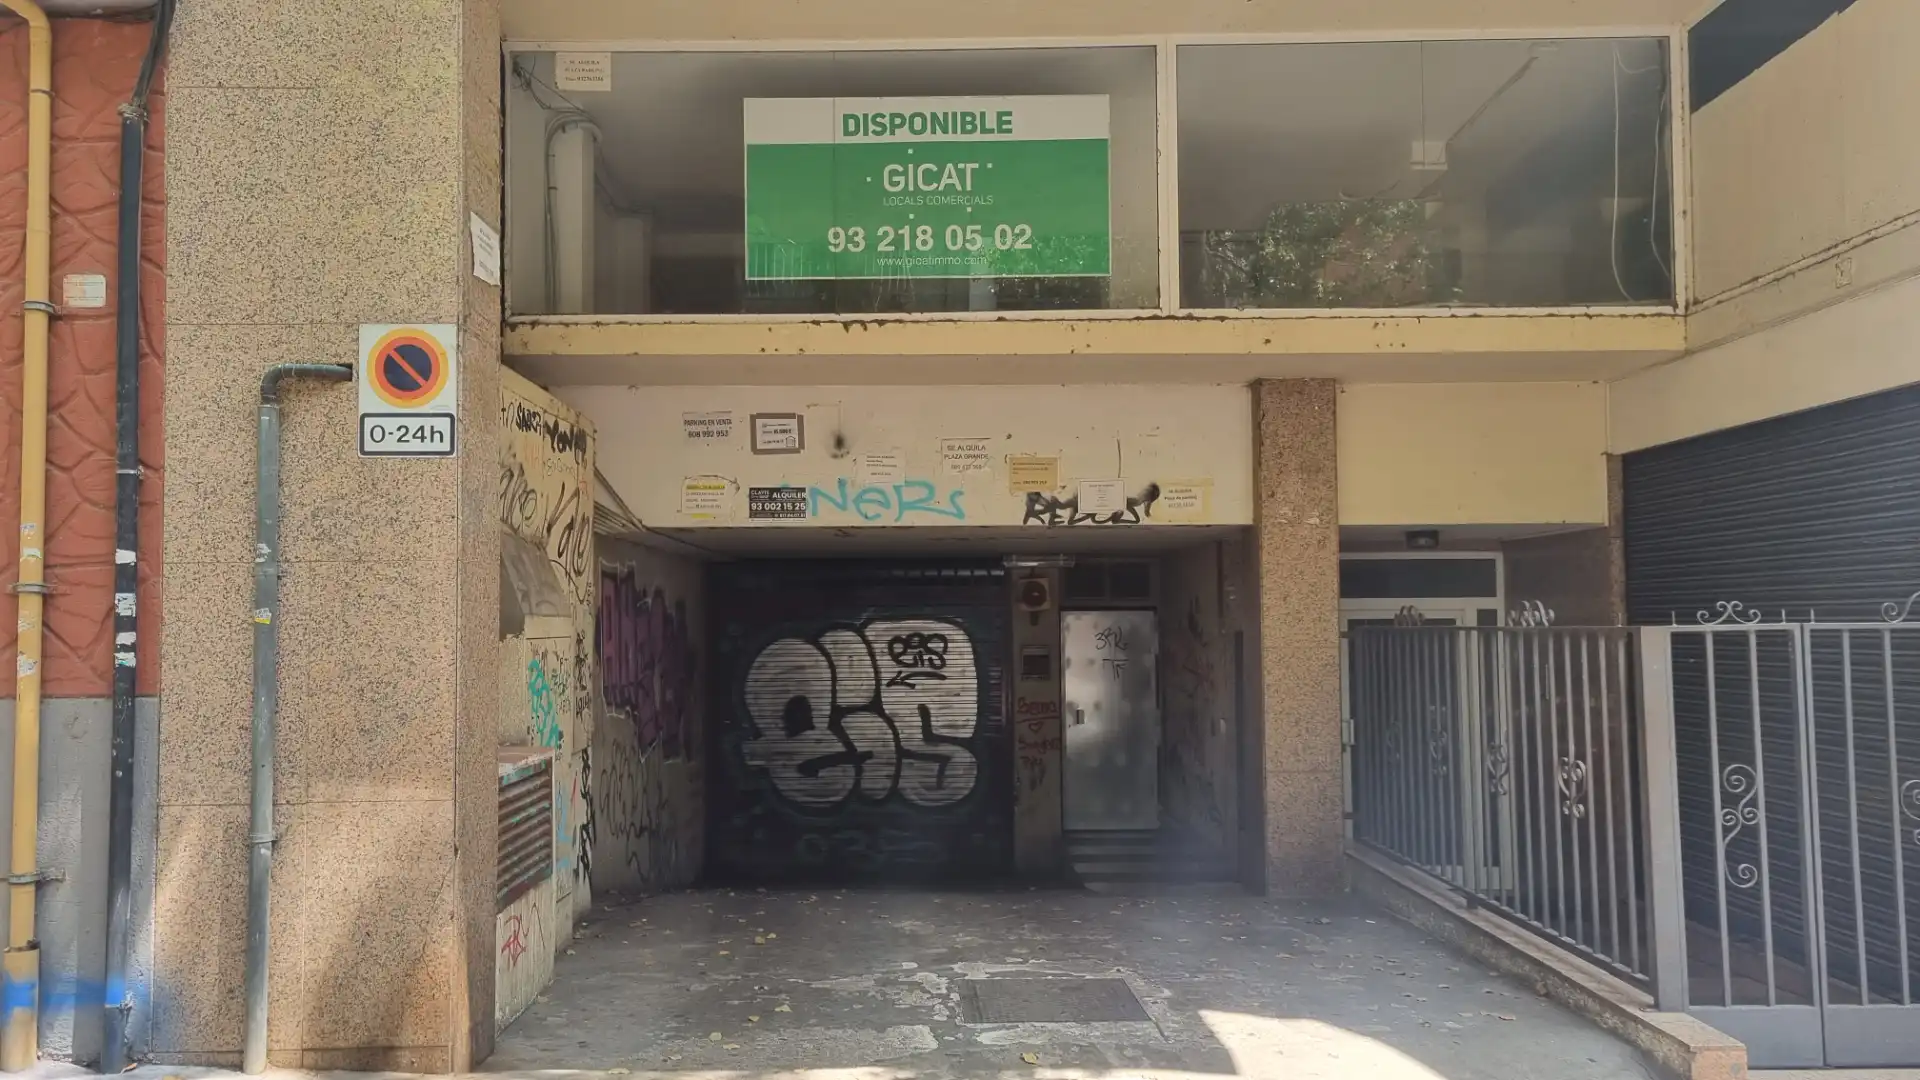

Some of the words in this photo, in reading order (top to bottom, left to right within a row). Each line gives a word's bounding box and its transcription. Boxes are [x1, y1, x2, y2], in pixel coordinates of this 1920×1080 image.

[842, 110, 1013, 137] DISPONIBLE
[883, 162, 979, 192] GICAT
[883, 195, 924, 207] LOCALS
[926, 195, 994, 206] COMERCIALS
[827, 226, 866, 253] 93
[876, 225, 934, 252] 218
[945, 224, 983, 251] 05
[994, 223, 1033, 250] 02
[876, 255, 987, 268] www.gicatimmo.com
[715, 418, 732, 426] VENTA
[369, 424, 444, 444] 0-24h
[772, 491, 807, 499] ALQUILER
[751, 502, 763, 511] 93
[764, 502, 782, 511] 002
[783, 502, 793, 511] 15
[794, 502, 806, 511] 25
